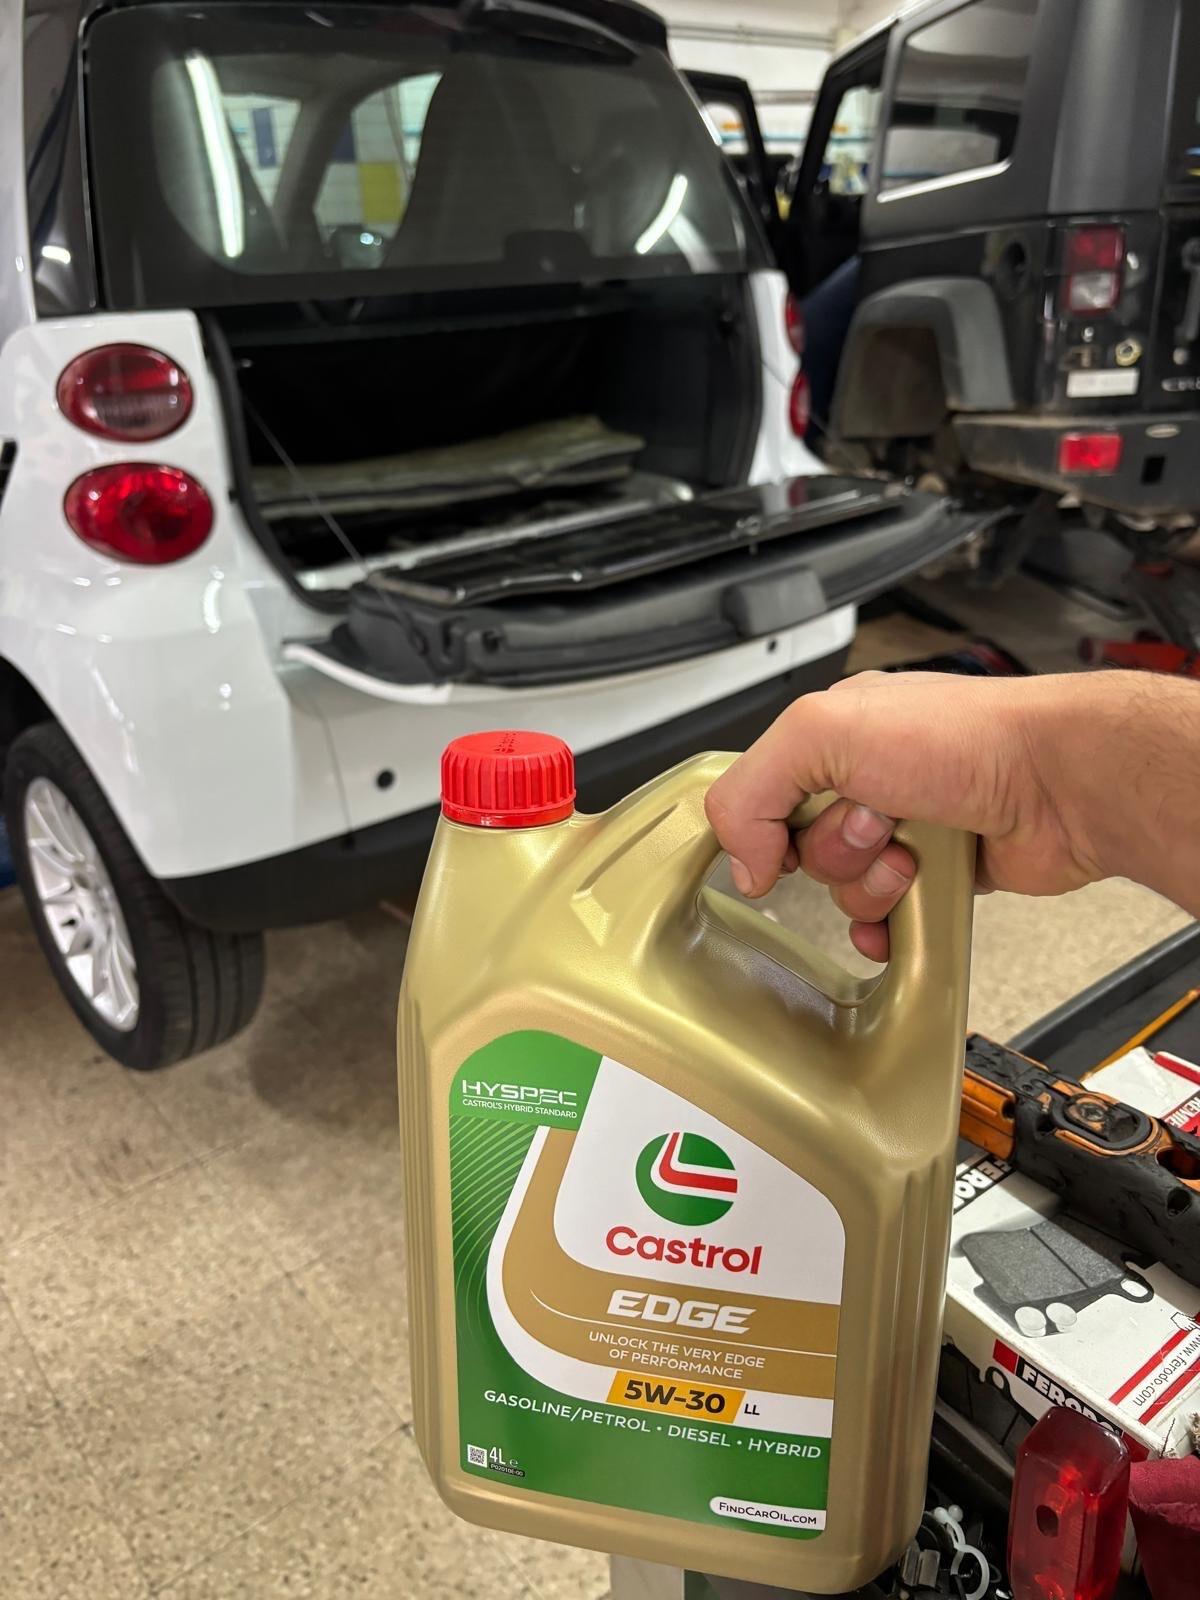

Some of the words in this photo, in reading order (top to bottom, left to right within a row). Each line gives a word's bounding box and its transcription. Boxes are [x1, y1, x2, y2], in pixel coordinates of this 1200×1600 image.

[462, 1079, 577, 1106] HYSPEC
[462, 1098, 502, 1110] CASTROL'S
[504, 1103, 534, 1113] HYBRID
[535, 1106, 577, 1118] STANDARD
[606, 1226, 762, 1274] Castrol
[607, 1289, 757, 1334] EDGE
[589, 1331, 648, 1350] UNLOCK
[651, 1341, 679, 1355] THE
[683, 1346, 722, 1361] VERY
[724, 1353, 766, 1368] EDGE
[609, 1349, 628, 1360] OF
[631, 1352, 744, 1379] PERFORMANCE
[624, 1379, 726, 1414] 5W-30
[744, 1403, 760, 1416] LL
[484, 1390, 651, 1432] GASOLINE/PETROL
[668, 1424, 731, 1447] DIESEL
[748, 1438, 821, 1459] HYBRID
[489, 1446, 506, 1465] 4L
